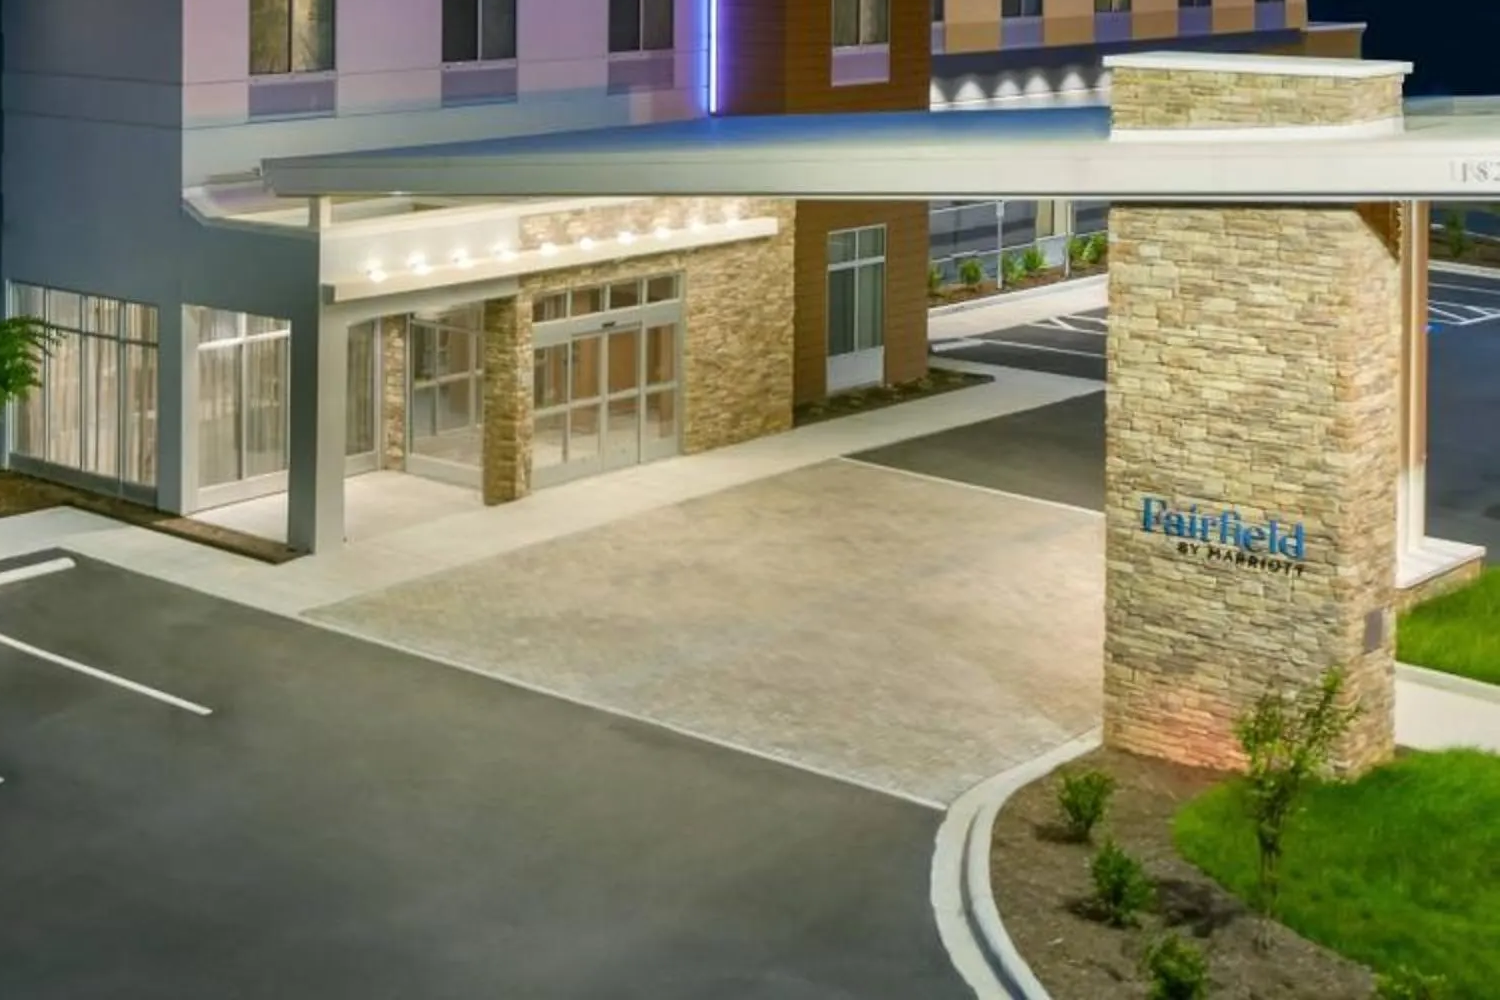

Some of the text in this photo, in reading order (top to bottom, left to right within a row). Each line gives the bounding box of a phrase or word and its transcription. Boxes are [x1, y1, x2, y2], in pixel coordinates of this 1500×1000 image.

[1142, 496, 1306, 560] Fairfield
[1177, 541, 1306, 576] BY MARRIOTT
